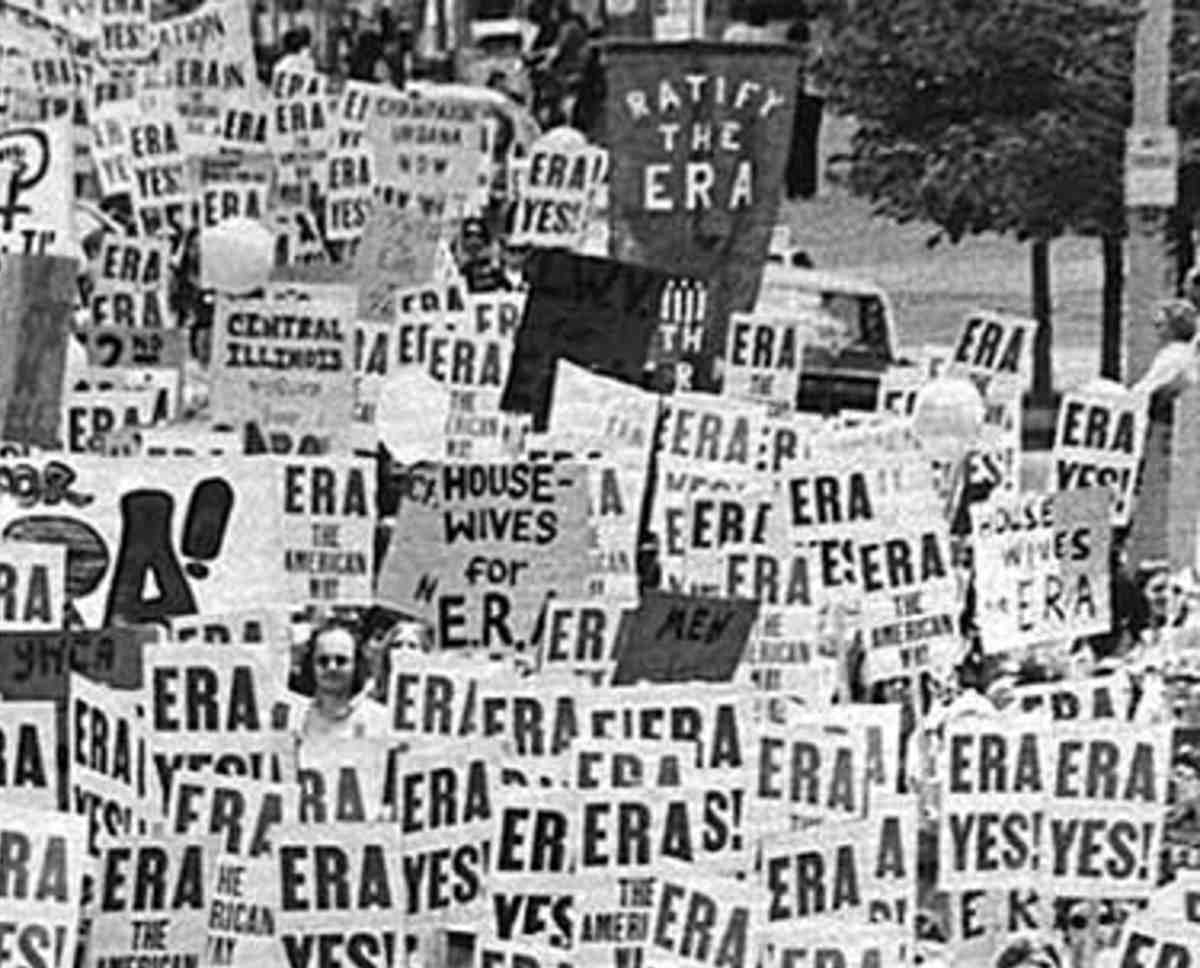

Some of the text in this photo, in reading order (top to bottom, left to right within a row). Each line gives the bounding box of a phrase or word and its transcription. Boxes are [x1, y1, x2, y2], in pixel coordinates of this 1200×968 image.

[276, 101, 325, 134] ERA
[625, 74, 785, 120] RATIFY
[131, 123, 179, 157] ERA
[223, 109, 268, 142] ERA
[657, 121, 743, 153] THE
[329, 155, 371, 189] ERA
[644, 161, 754, 212] ERA
[204, 191, 261, 227] ERA
[103, 245, 161, 284] ERA
[225, 312, 346, 343] CENTRAL
[731, 321, 797, 371] ERA
[954, 317, 1026, 375] ERA
[225, 341, 344, 374] ILLINOIS
[428, 336, 501, 387] ERA
[672, 407, 752, 465] ERA
[1062, 400, 1136, 456] ERA
[283, 464, 369, 517] ERA
[443, 463, 574, 503] HOUSE-
[789, 472, 875, 528] ERA
[443, 507, 559, 545] WIVES
[727, 553, 813, 606] ERA
[859, 532, 947, 592] ERA
[656, 607, 737, 646] MEN
[152, 665, 261, 732] ERA
[74, 697, 132, 786] ERA
[484, 696, 579, 757] ERA
[639, 703, 744, 769] ERA
[756, 734, 856, 813] ERA
[950, 732, 1044, 795] ERA
[1054, 740, 1157, 802] ERA
[401, 760, 493, 834] ERA
[582, 801, 695, 867] ERA
[949, 810, 1044, 873] YES!
[1050, 818, 1156, 881] YES!
[100, 845, 205, 912] ERA
[279, 844, 392, 912] ERA
[617, 876, 657, 907] THE
[766, 843, 862, 923] ERA
[131, 919, 171, 951] THE
